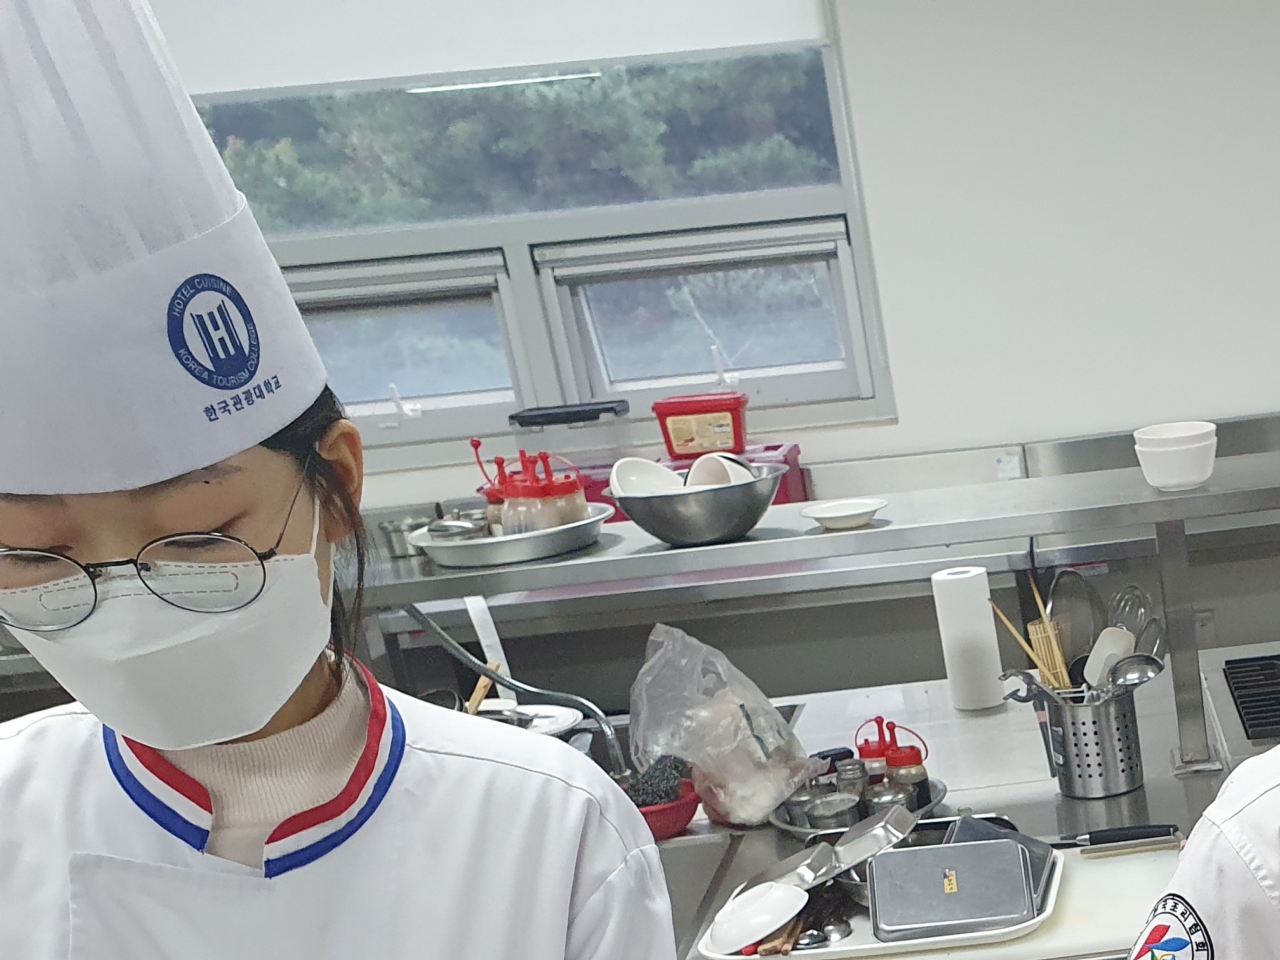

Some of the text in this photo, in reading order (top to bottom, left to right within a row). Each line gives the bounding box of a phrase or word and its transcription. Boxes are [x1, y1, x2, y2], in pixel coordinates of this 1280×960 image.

[173, 278, 233, 317] HOTEL CUISINE
[178, 348, 209, 381] KOREA
[212, 369, 249, 387] TOURISM
[203, 375, 282, 422] 한국관광대학교
